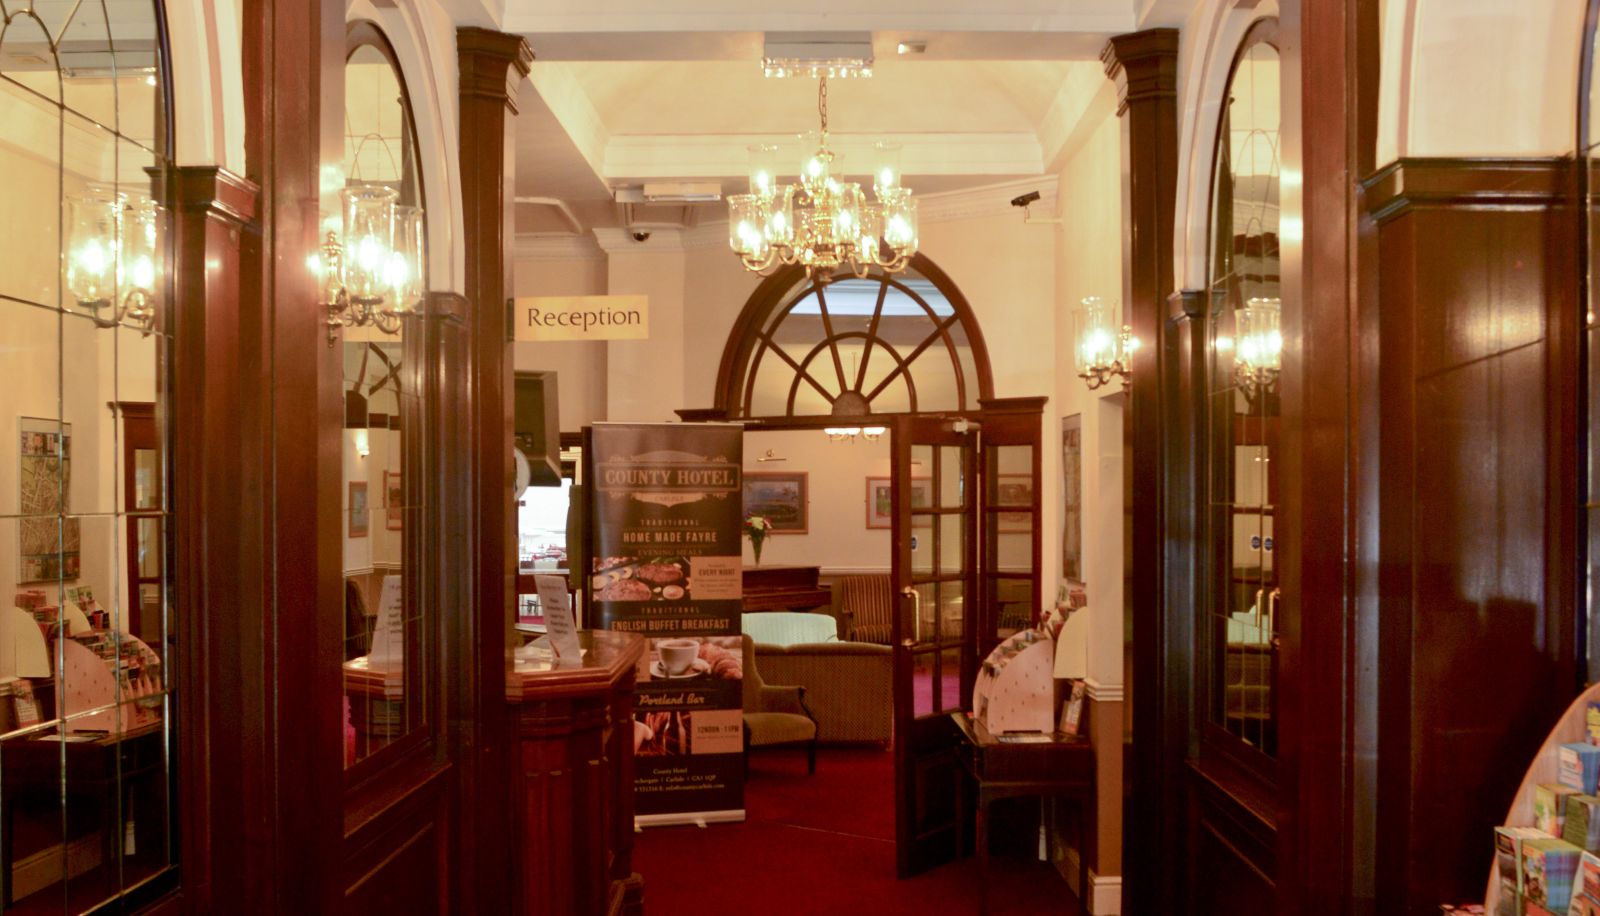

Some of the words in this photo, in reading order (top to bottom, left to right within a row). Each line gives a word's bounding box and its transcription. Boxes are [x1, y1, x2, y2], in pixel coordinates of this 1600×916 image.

[528, 307, 640, 332] Reception
[605, 469, 671, 485] COUNTY
[677, 469, 734, 485] HOTEL
[623, 532, 650, 543] HOME
[655, 532, 682, 543] MADE
[686, 531, 718, 543] FAYRE
[698, 568, 717, 576] EVERY
[718, 568, 735, 576] NIGHT
[611, 620, 647, 632] ENGLISH
[648, 619, 680, 631] BUFFET
[681, 618, 730, 630] BREAKFAST
[639, 692, 684, 705] Portland
[686, 693, 705, 704] Bar
